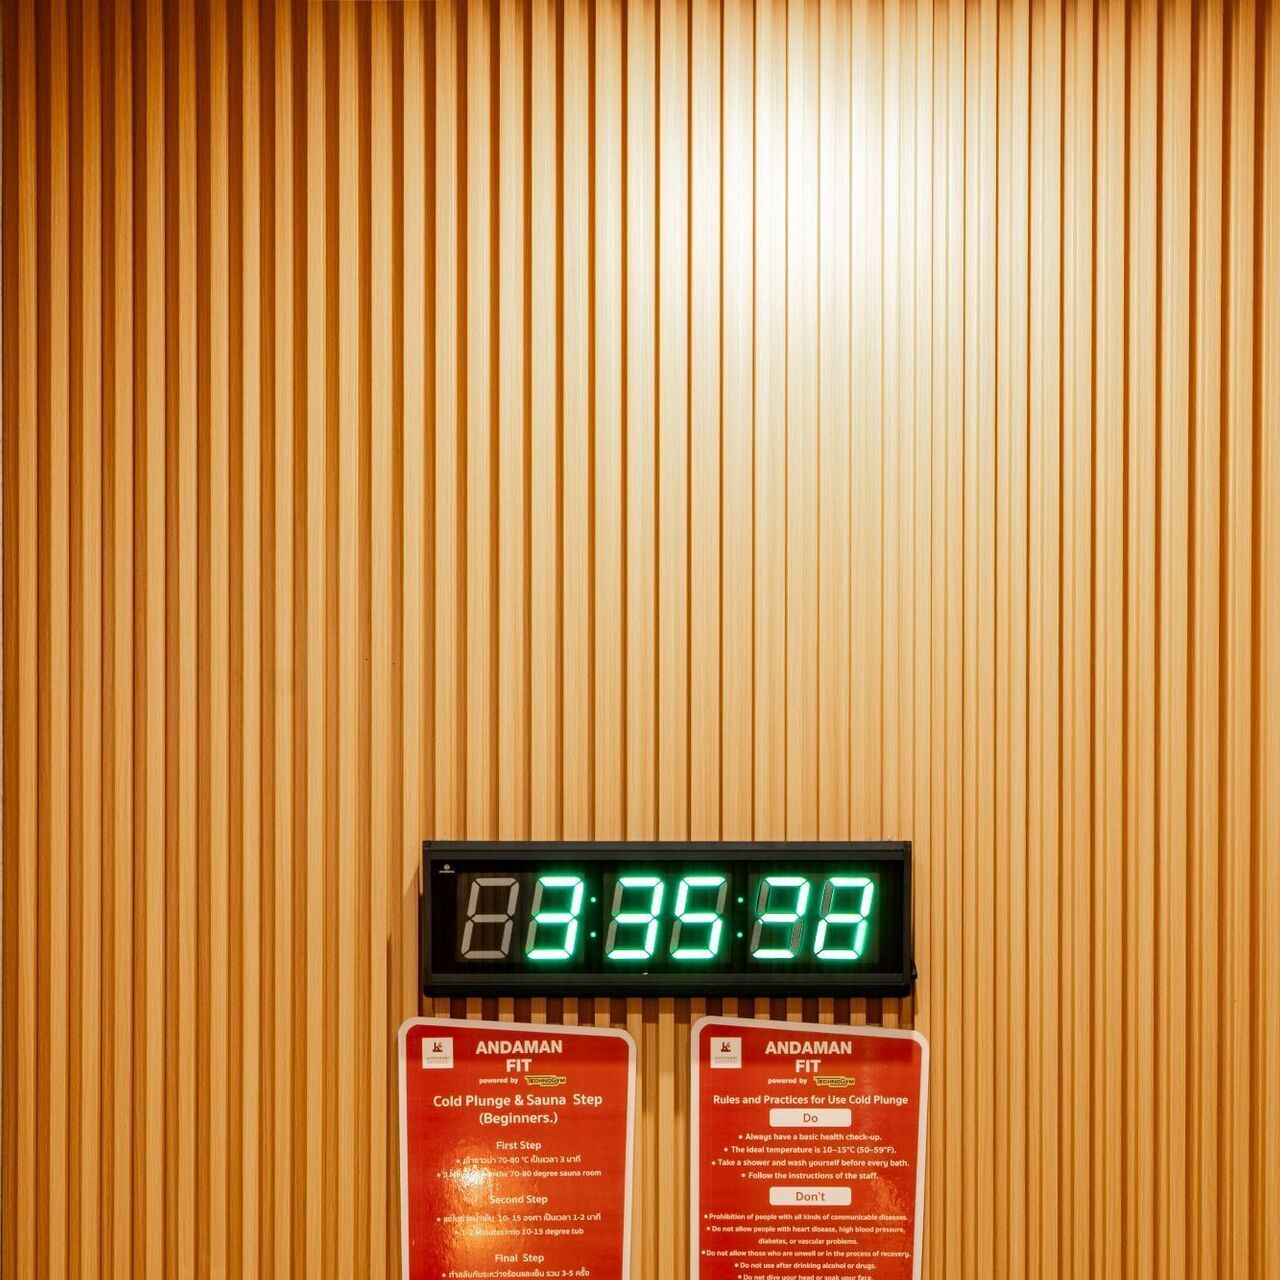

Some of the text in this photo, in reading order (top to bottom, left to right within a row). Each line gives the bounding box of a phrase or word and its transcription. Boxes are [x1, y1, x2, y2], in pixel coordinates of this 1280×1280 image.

[476, 1040, 563, 1054] ANDAMAN
[765, 1040, 852, 1055] ANDAMAN
[506, 1058, 532, 1073] FIT
[795, 1059, 821, 1073] FIT
[478, 1076, 566, 1086] powered by TECHNOGYM
[767, 1077, 856, 1087] powered by TECHNOGYM
[433, 1093, 603, 1109] Cold Plunge & Sauna Step
[713, 1094, 908, 1106] Rules and Practices for Use Cold Plunge
[479, 1112, 558, 1126] (Beginners.)
[803, 1112, 818, 1123] Do
[745, 1132, 772, 1142] Always
[798, 1132, 819, 1141] basic
[820, 1133, 844, 1141] health
[845, 1132, 882, 1142] check-up.
[496, 1140, 542, 1152] First Step
[731, 1145, 821, 1155] The ideal temperature is
[718, 1158, 736, 1166] Take
[743, 1158, 770, 1166] shower
[771, 1158, 786, 1166] and
[787, 1159, 807, 1167] wash
[808, 1158, 840, 1168] yourself
[840, 1158, 866, 1167] before
[867, 1160, 889, 1168] every
[889, 1159, 910, 1167] bath.
[533, 1170, 559, 1179] degree
[748, 1171, 879, 1180] Follow the instructions of the staff.
[489, 1194, 548, 1205] Second Step
[796, 1191, 825, 1202] Don't
[754, 1213, 778, 1221] people
[803, 1213, 822, 1221] kinds
[522, 1228, 544, 1236] 10-15
[545, 1228, 570, 1237] degree
[753, 1225, 776, 1234] people
[792, 1225, 810, 1233] heart
[811, 1225, 838, 1233] disease,
[838, 1225, 854, 1234] high
[854, 1225, 874, 1233] blood
[875, 1226, 906, 1234] pressure,
[758, 1237, 788, 1245] diabetes,
[825, 1238, 859, 1246] problems.
[494, 1252, 545, 1264] Final Step
[729, 1249, 747, 1257] allow
[747, 1249, 766, 1257] those
[767, 1249, 782, 1257] who
[776, 1261, 792, 1269] after
[793, 1262, 822, 1270] drinking
[855, 1262, 877, 1271] drugs.
